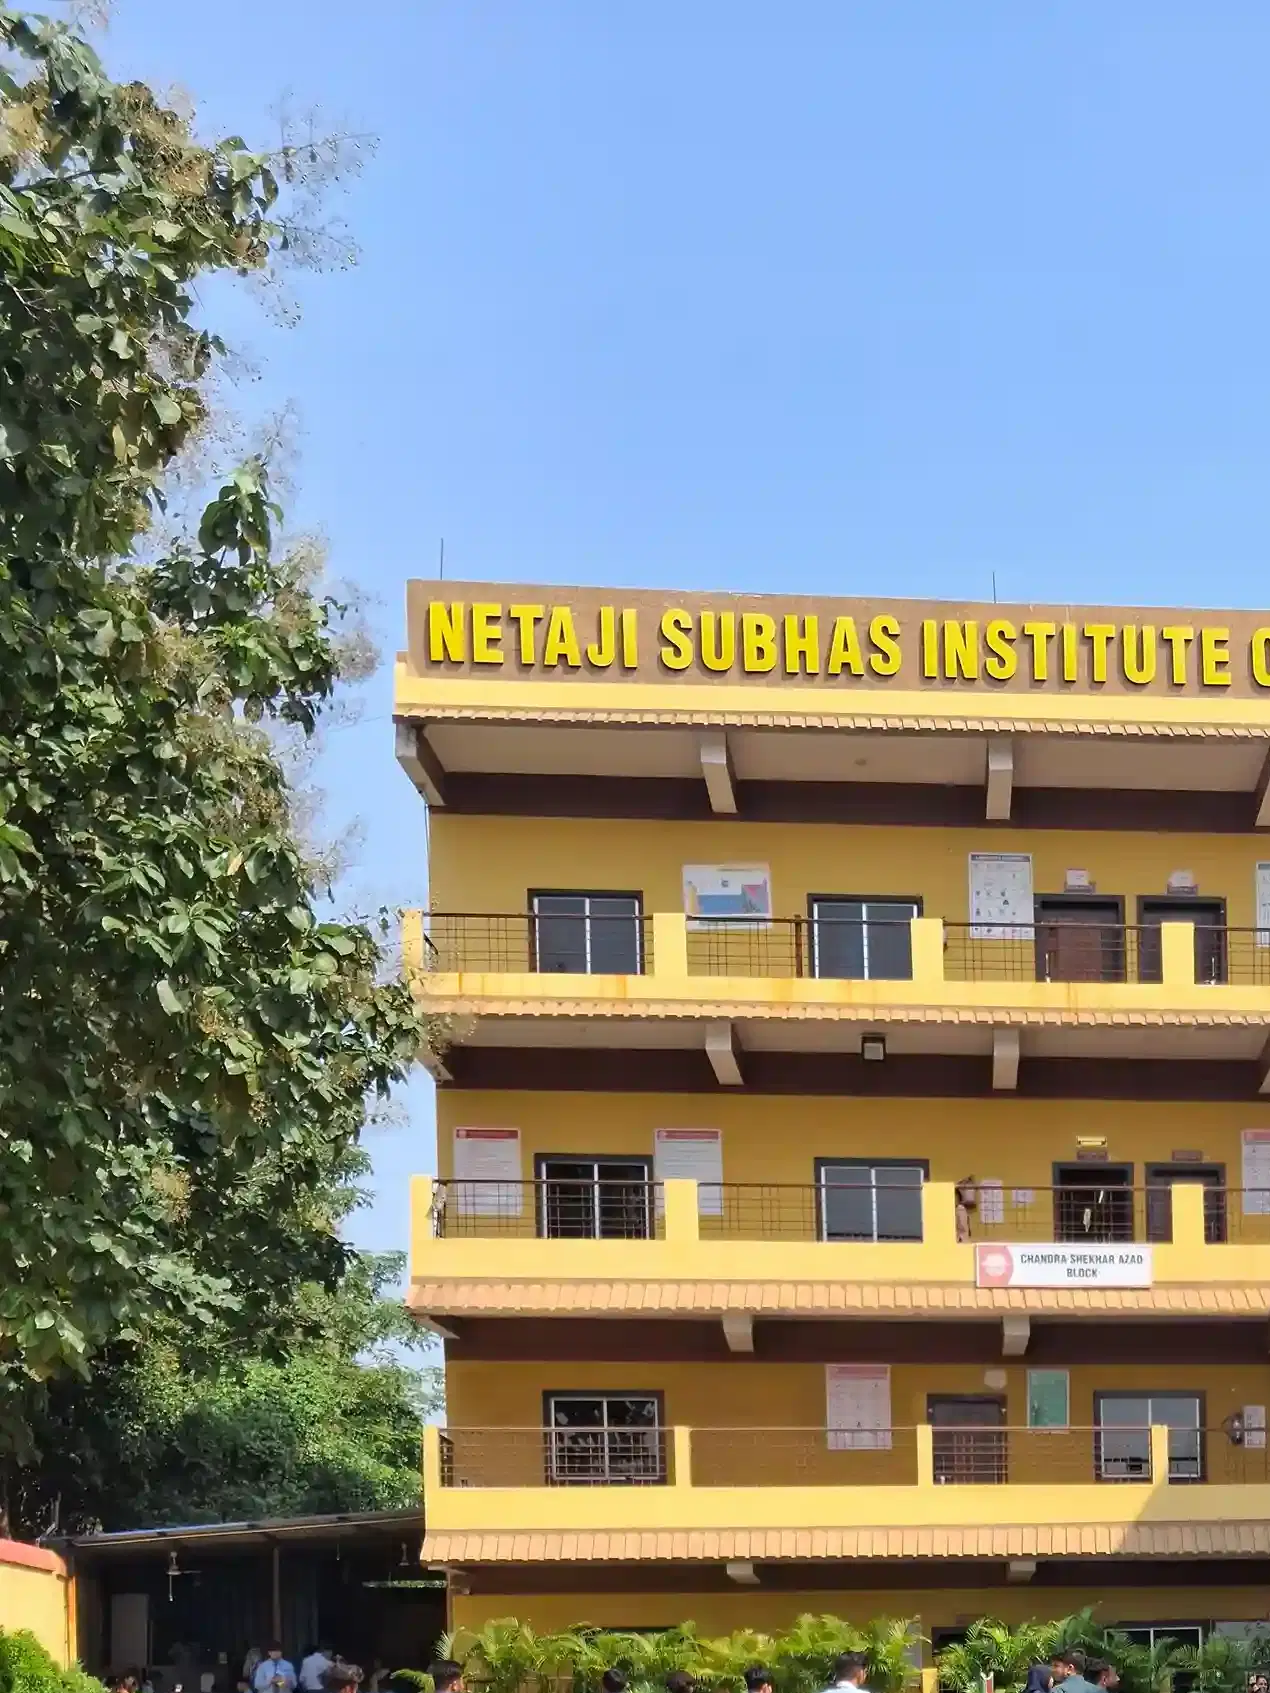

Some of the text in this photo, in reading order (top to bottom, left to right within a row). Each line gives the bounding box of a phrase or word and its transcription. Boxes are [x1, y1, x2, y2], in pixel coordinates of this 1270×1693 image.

[429, 602, 638, 667] NETAJI
[660, 608, 902, 675] SUBHAS
[923, 618, 1231, 686] INSTITUTE
[1020, 1254, 1144, 1264] CHANDRA SHEKHAR AZAD
[1066, 1268, 1098, 1278] BLOCK
